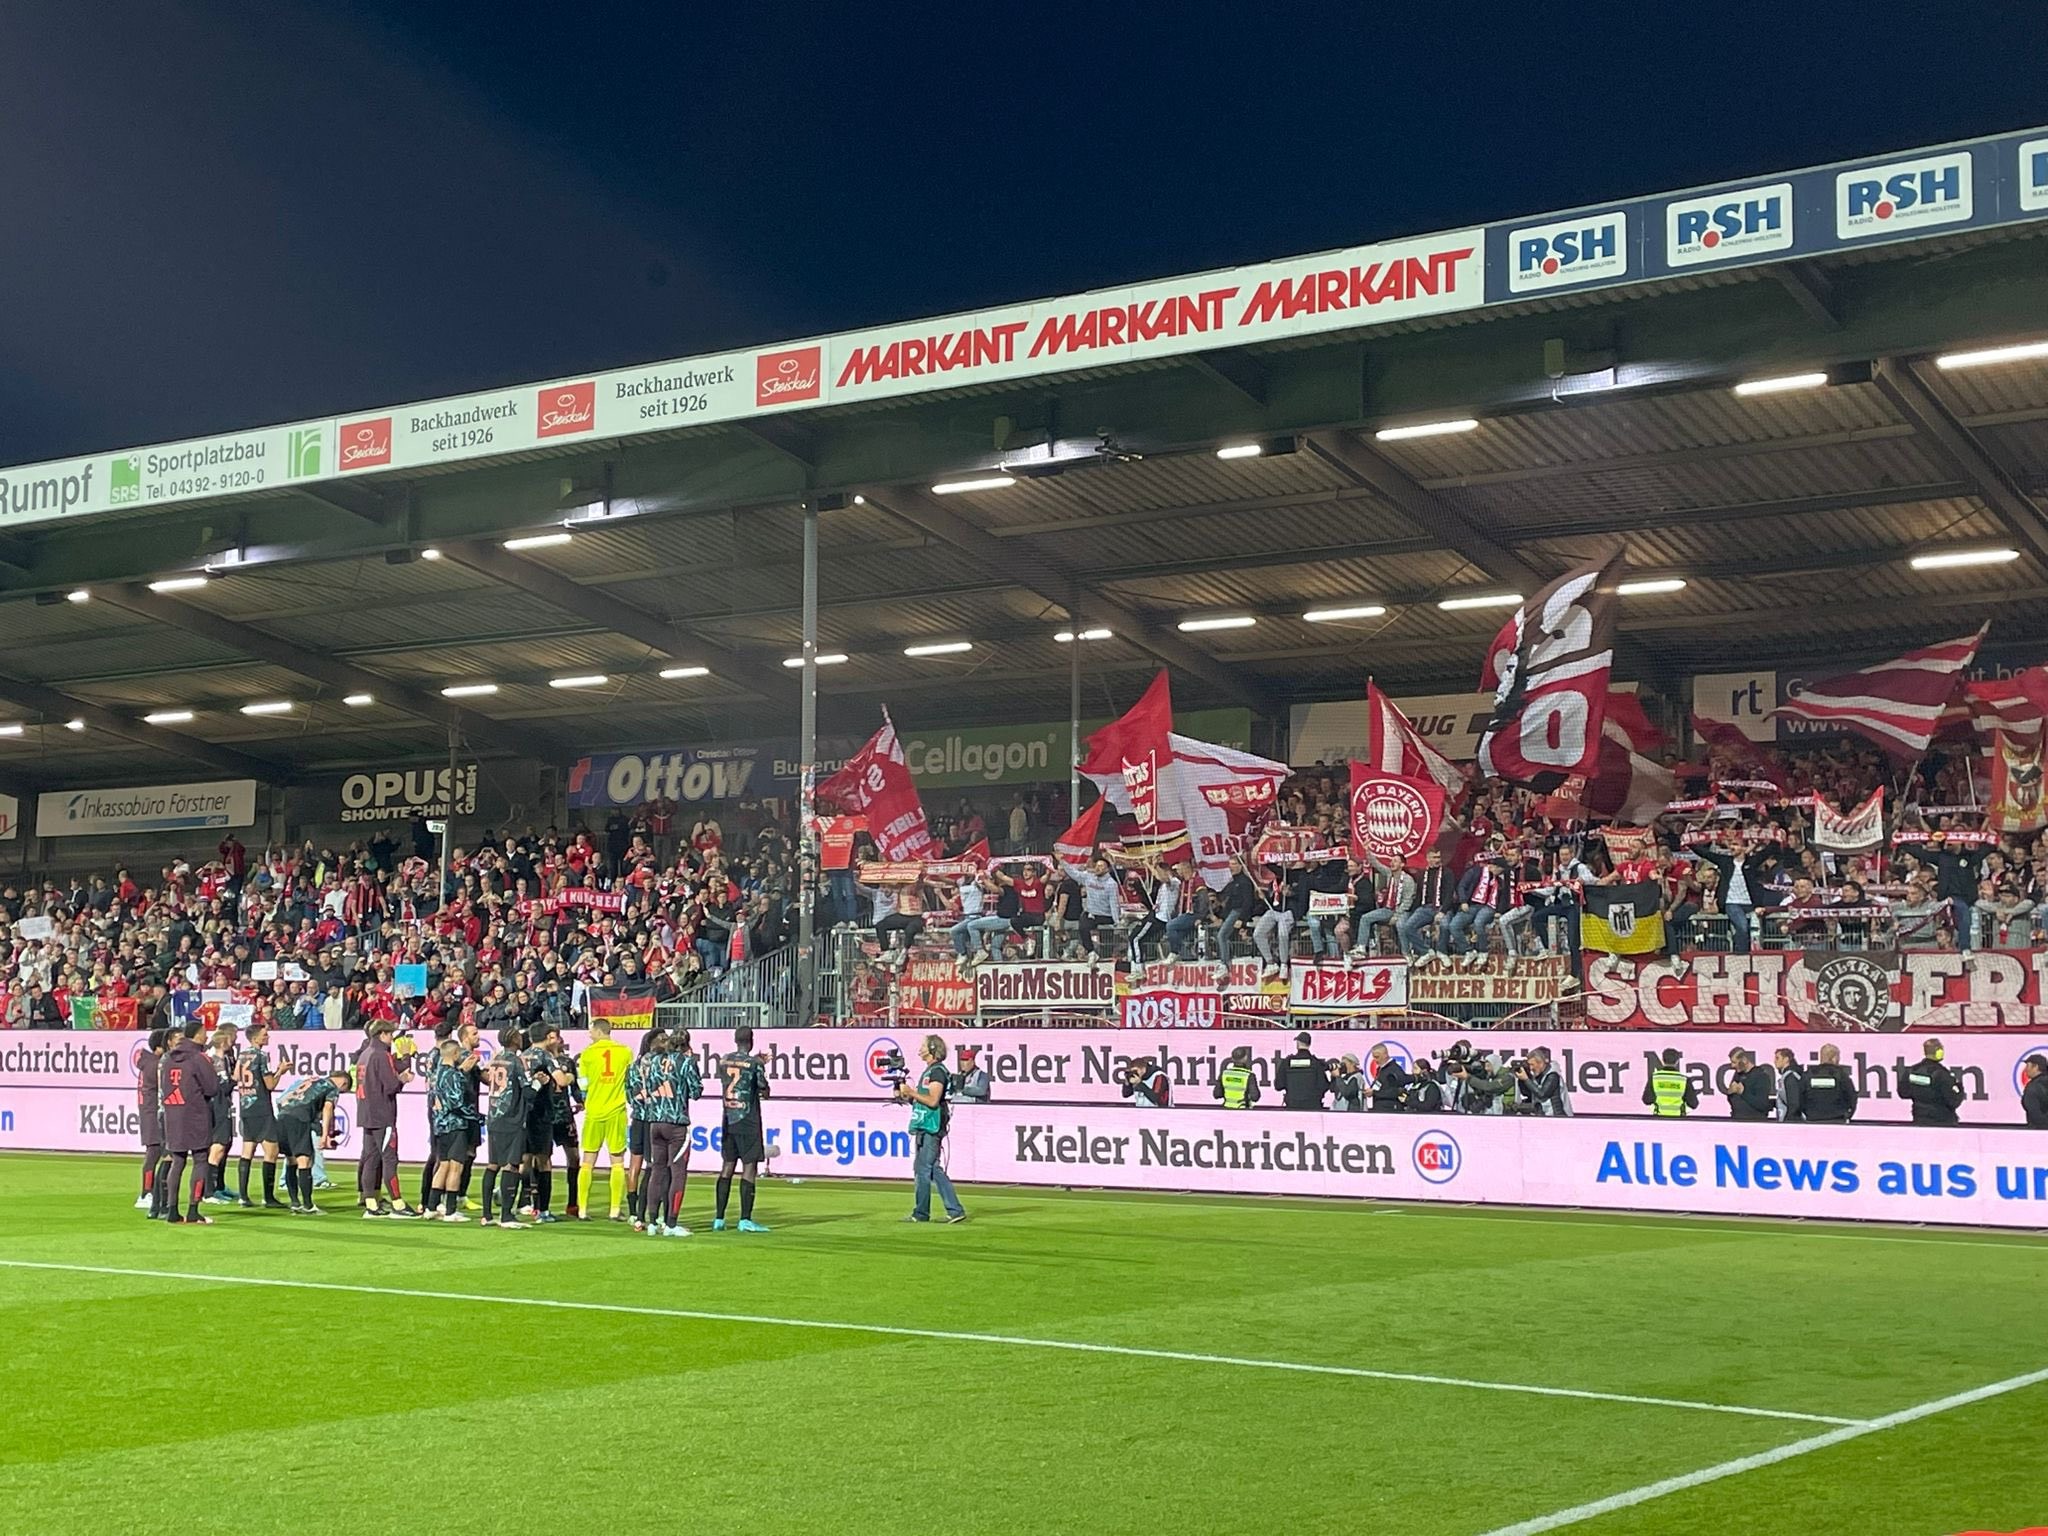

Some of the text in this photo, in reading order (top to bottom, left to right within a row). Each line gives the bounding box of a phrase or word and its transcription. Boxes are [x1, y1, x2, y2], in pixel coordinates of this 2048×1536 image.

[836, 247, 1476, 388] MARKANT MARKANT MARKANT
[615, 365, 735, 400] Backhandwerk
[760, 368, 817, 398] Steiskal
[410, 400, 518, 434] Backhandwerk
[541, 402, 592, 431] Steiskal
[639, 393, 708, 420] seit 1926
[431, 427, 494, 453] seit 1926
[146, 441, 266, 478] Sportplatzbau
[110, 483, 140, 504] SRS
[146, 483, 167, 500] Tel.
[1731, 679, 1763, 716] rt
[773, 758, 849, 776] Bueru
[905, 735, 1048, 781] Cellagon
[341, 767, 466, 809] OPUS
[606, 752, 756, 804] Ottow
[80, 793, 166, 819] Inkassobüro
[168, 793, 232, 814] Förstner
[1376, 785, 1424, 818] BAYERN
[979, 967, 1113, 1002] alarMstufe
[1302, 968, 1392, 1002] REBELS
[1410, 978, 1560, 1000] IMMER BEI UN
[1126, 995, 1216, 1028] RÖSLAU
[0, 1042, 119, 1074] chrichten
[601, 1049, 615, 1077] 1
[79, 1104, 140, 1135] Kiele
[791, 1118, 910, 1166] Region
[1014, 1124, 1396, 1175] Kieler Nachrichten
[1423, 1146, 1453, 1170] KN
[1596, 1139, 1698, 1189] Alle
[1714, 1143, 1860, 1194] News
[1876, 1159, 1977, 1200] aus
